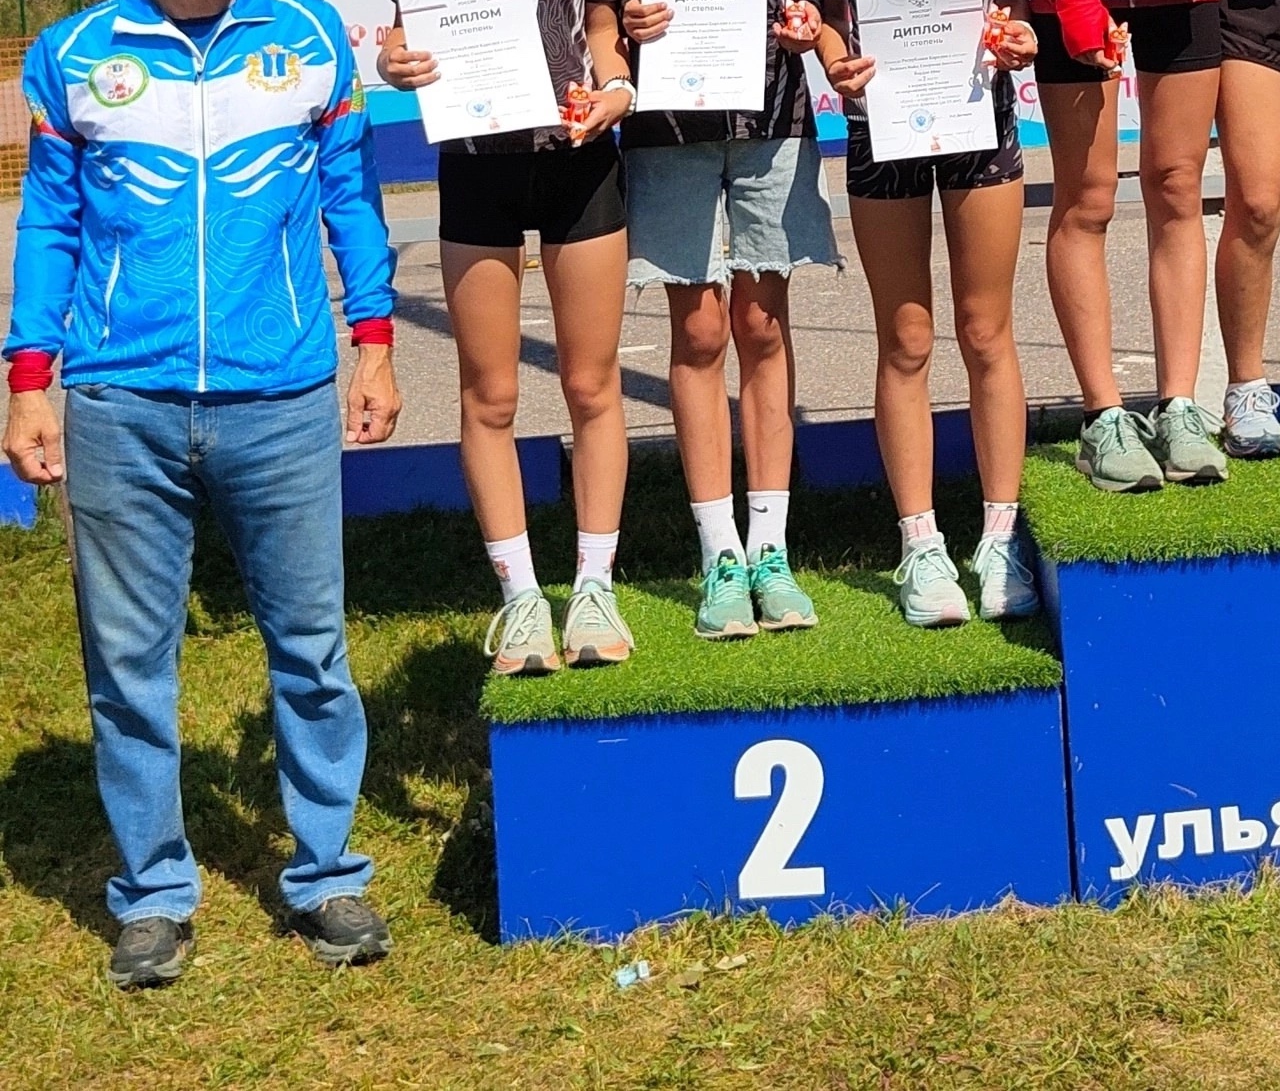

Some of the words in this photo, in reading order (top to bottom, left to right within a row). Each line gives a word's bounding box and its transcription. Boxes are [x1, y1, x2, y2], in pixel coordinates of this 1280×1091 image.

[440, 7, 502, 28] ДИПЛОМ
[893, 22, 953, 40] ДИПЛОМ
[910, 38, 944, 47] степень
[735, 738, 826, 900] 2
